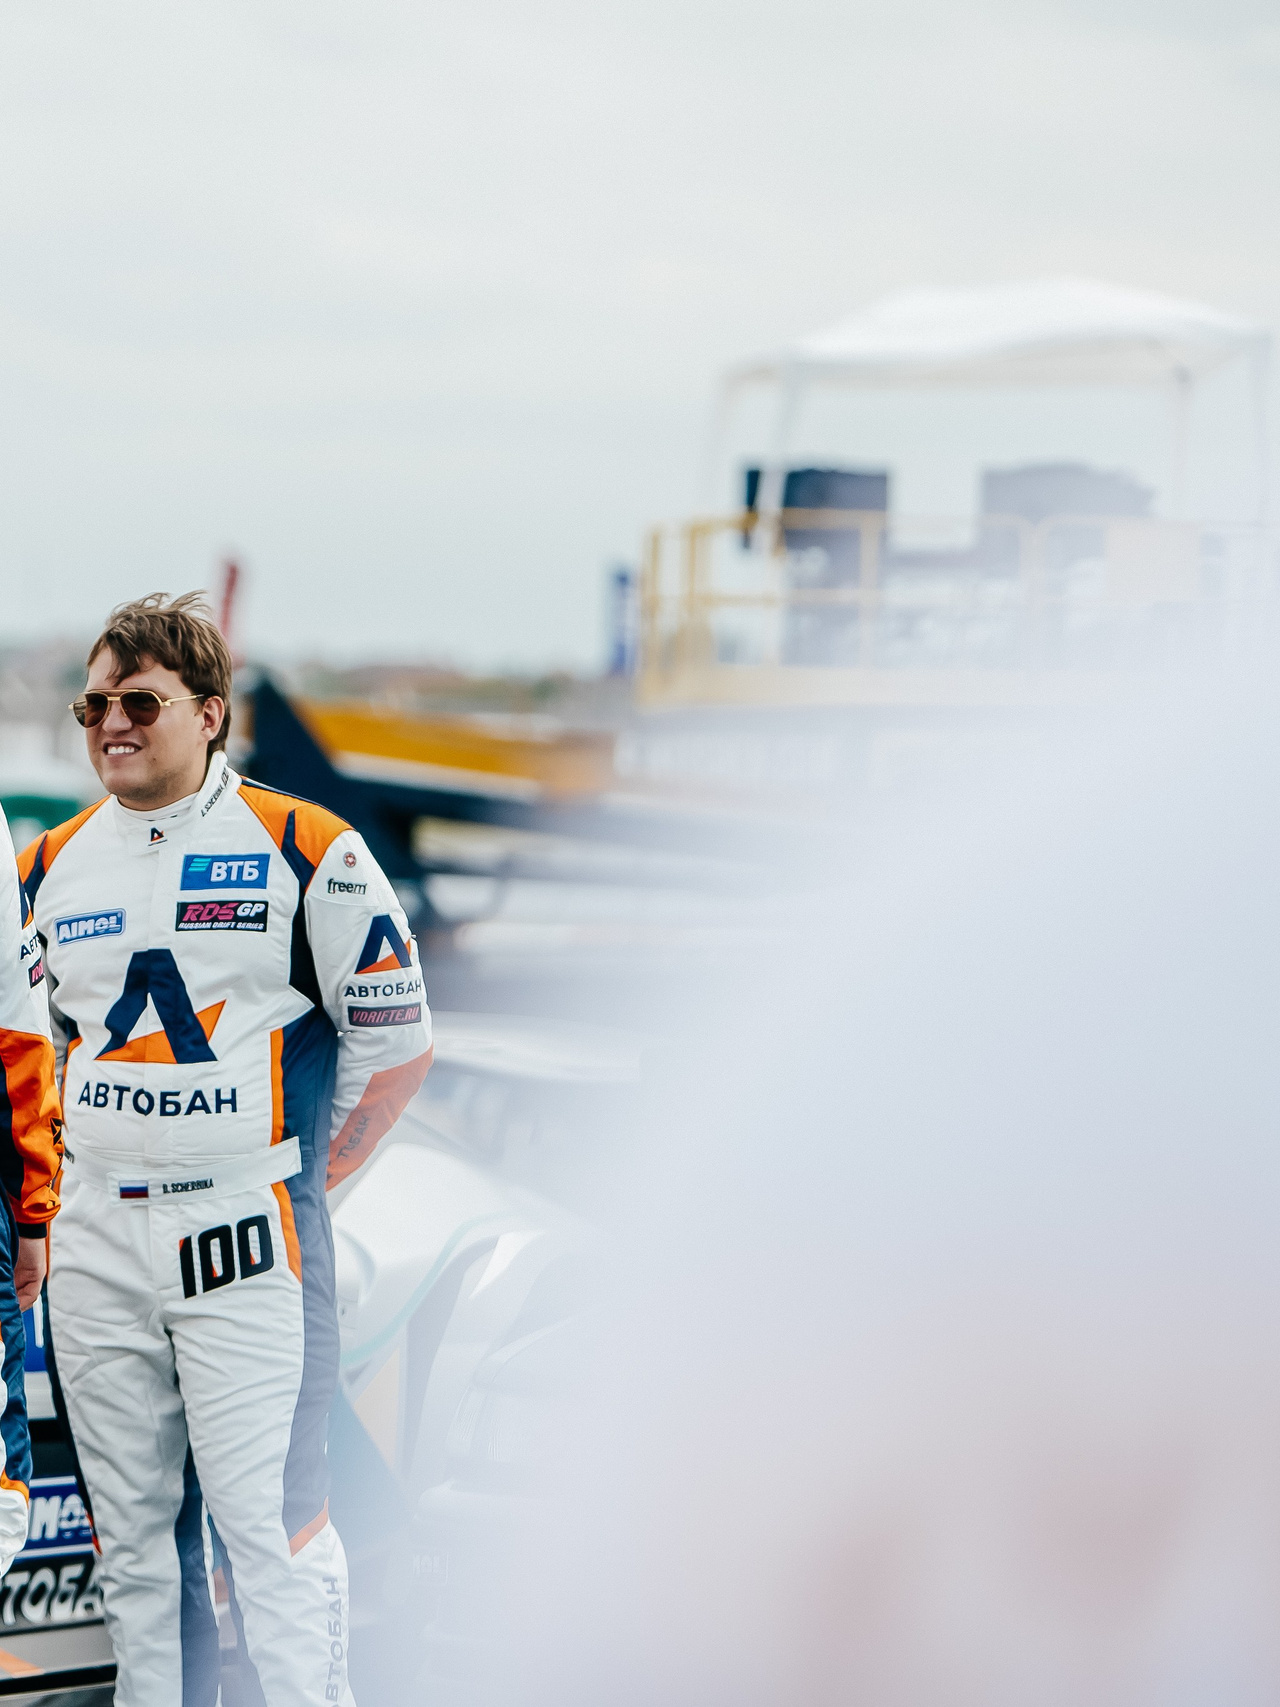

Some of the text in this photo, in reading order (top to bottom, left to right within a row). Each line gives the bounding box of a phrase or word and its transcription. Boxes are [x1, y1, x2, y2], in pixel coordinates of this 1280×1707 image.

[210, 860, 260, 882] ВТБ
[327, 878, 368, 895] freem
[182, 902, 266, 921] RDS GP
[236, 922, 265, 930] SERIES
[344, 978, 422, 998] АВТОБАН
[77, 1081, 238, 1117] АВТОБАН
[336, 1114, 372, 1159] ТОБАН
[179, 1214, 274, 1299] 100
[322, 1576, 344, 1707] ВТОБАН
